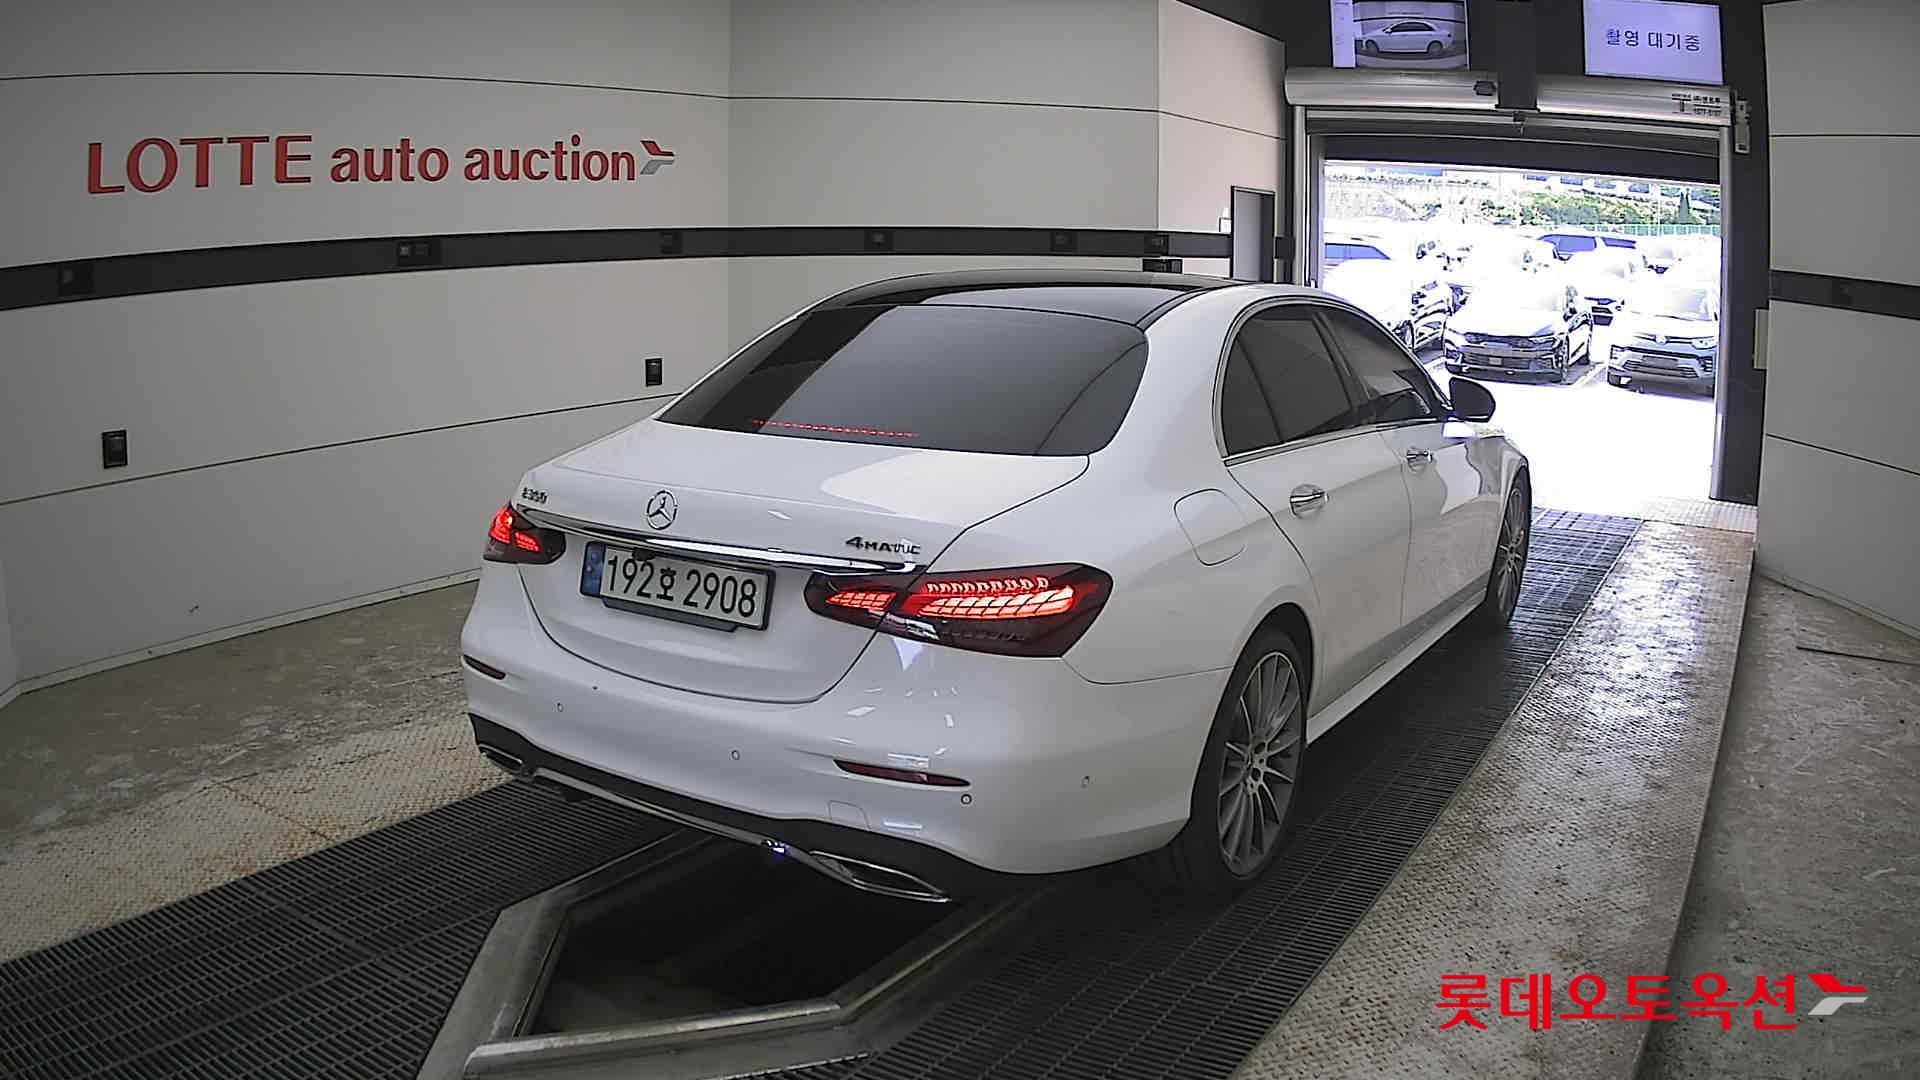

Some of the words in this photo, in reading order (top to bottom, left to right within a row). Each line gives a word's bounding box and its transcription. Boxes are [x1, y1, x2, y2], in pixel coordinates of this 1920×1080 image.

[1606, 28, 1639, 47] 촬영
[1648, 31, 1701, 52] 대기중
[88, 135, 312, 194] LOTTE
[330, 138, 449, 183] auto
[464, 134, 636, 182] auction
[607, 554, 677, 601] 192호
[683, 569, 757, 617] 2908
